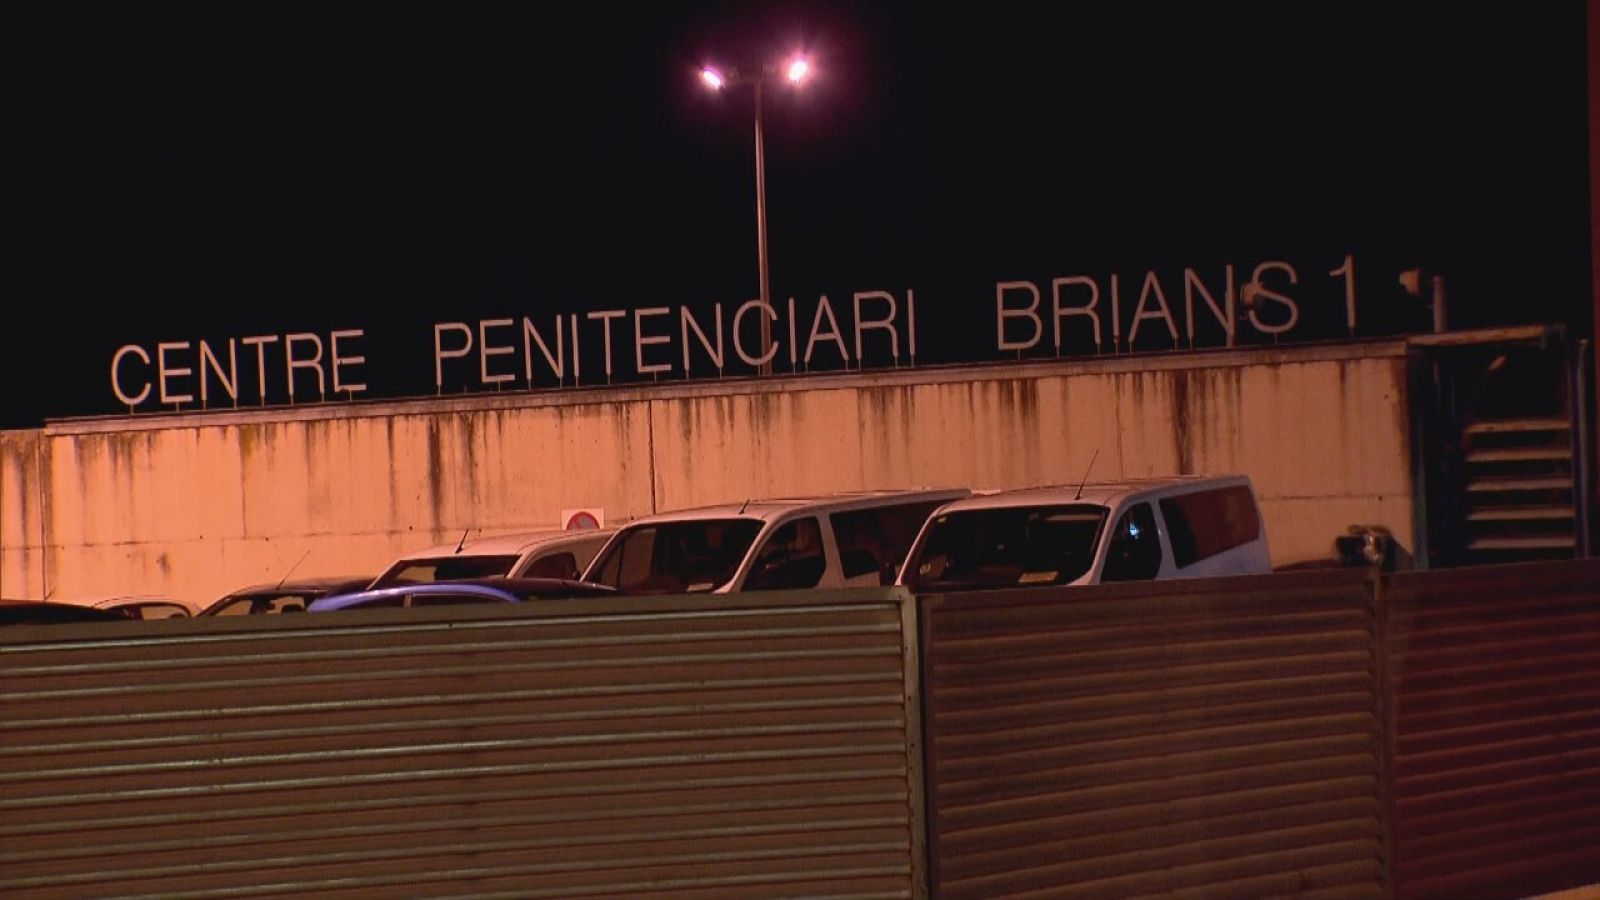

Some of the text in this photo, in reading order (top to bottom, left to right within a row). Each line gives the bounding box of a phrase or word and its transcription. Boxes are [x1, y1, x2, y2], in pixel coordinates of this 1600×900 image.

[111, 255, 1356, 405] CENTRE PENITENCIARI BRIANS 1
